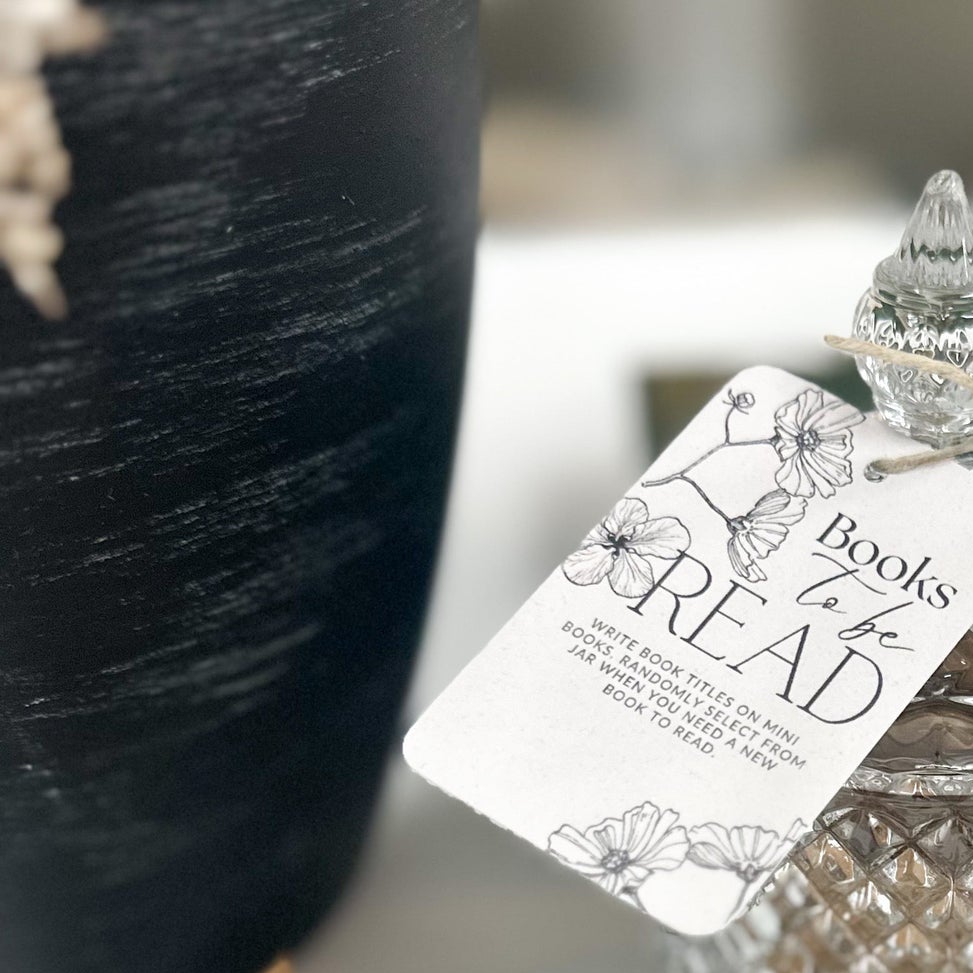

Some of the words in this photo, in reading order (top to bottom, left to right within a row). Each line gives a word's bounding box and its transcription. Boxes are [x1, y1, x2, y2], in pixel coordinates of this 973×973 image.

[796, 552, 887, 614] to
[816, 512, 958, 609] Books
[591, 618, 639, 651] WRITE
[639, 647, 685, 678] BOOK
[686, 673, 735, 708] TITLES
[736, 704, 763, 723] ON
[762, 719, 800, 746] MINI
[626, 549, 883, 725] READ
[838, 601, 915, 652] be
[561, 620, 614, 659] BOOKS.
[619, 654, 704, 708] RANDOMLY
[704, 705, 761, 741] SELECT
[760, 738, 806, 769] FROM
[567, 644, 597, 665] JAR
[599, 661, 646, 693] WHEN
[648, 689, 680, 714] YOU
[682, 711, 723, 740] NEED
[725, 738, 736, 749] A
[739, 745, 778, 771] NEW
[602, 684, 649, 715] BOOK
[650, 711, 671, 729] TO
[673, 725, 715, 758] READ.
